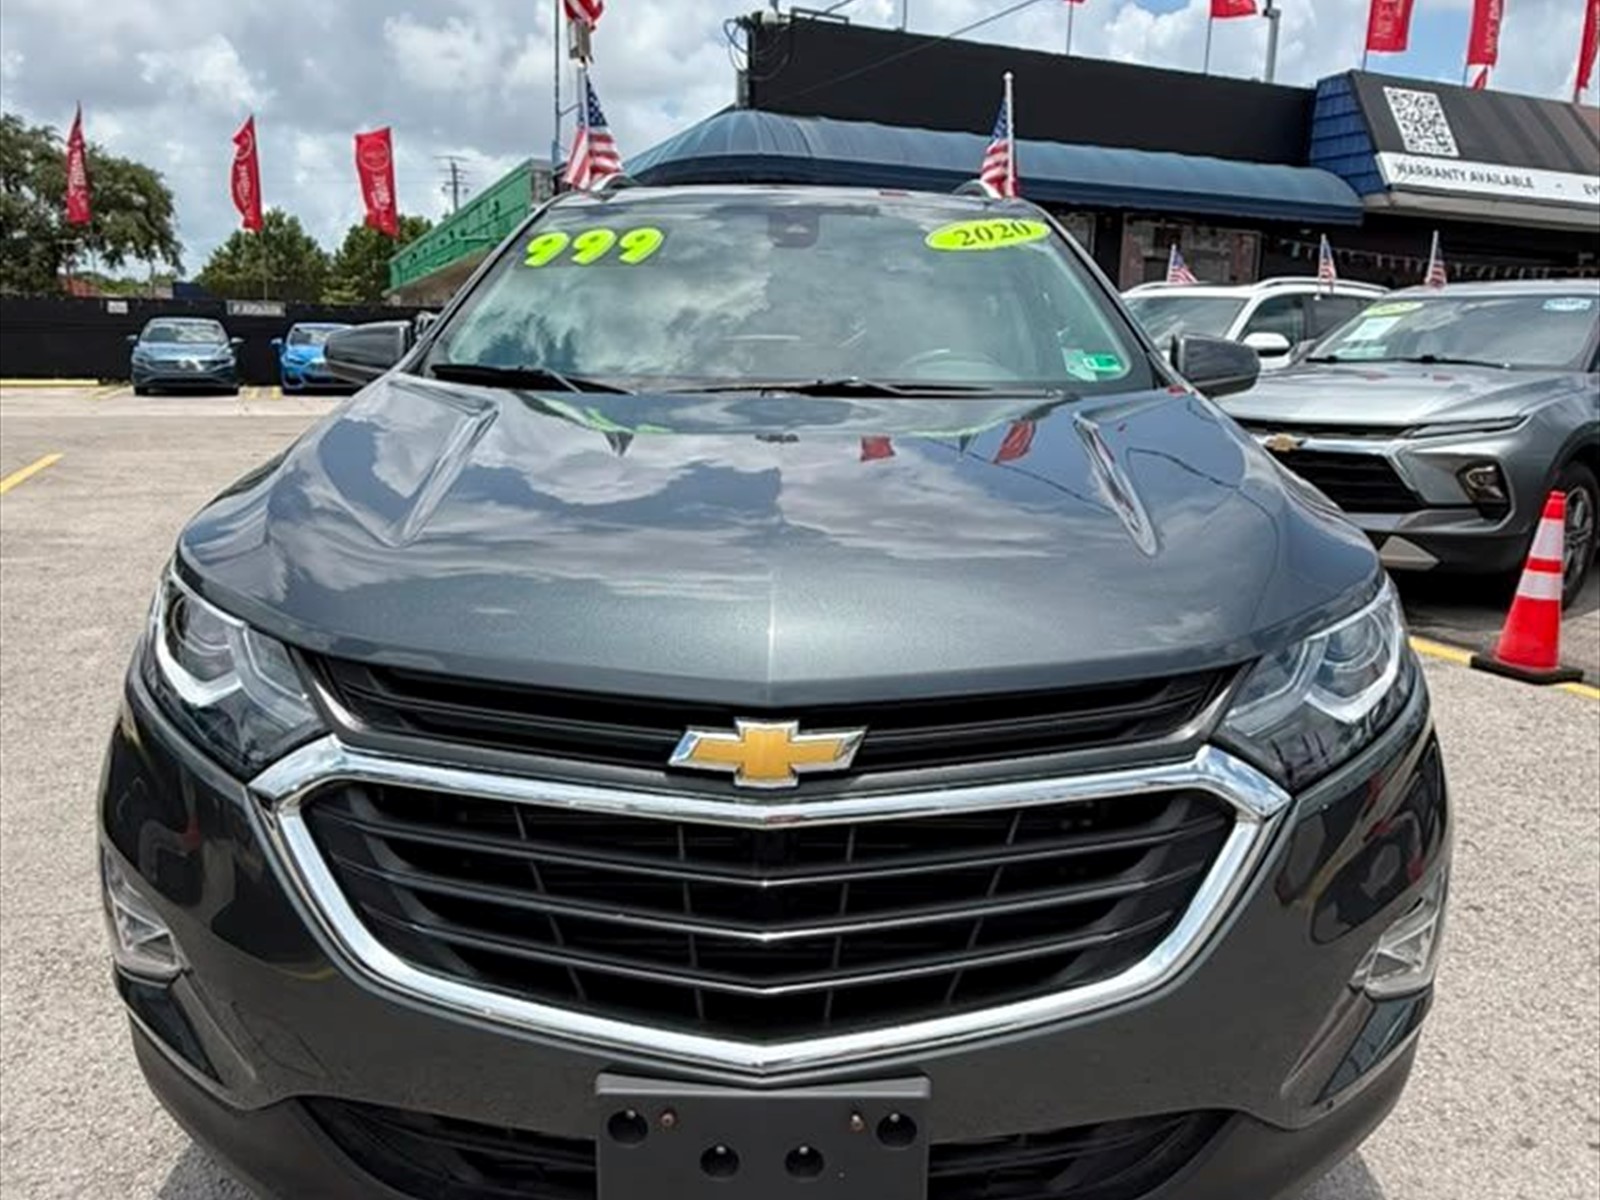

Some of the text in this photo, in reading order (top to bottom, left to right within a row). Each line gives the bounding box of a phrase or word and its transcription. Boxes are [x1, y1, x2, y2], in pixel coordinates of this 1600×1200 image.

[1395, 163, 1466, 181] WARRANTY
[1470, 171, 1534, 188] AVAILABLE
[953, 221, 1032, 246] 2020
[524, 228, 664, 267] 999
